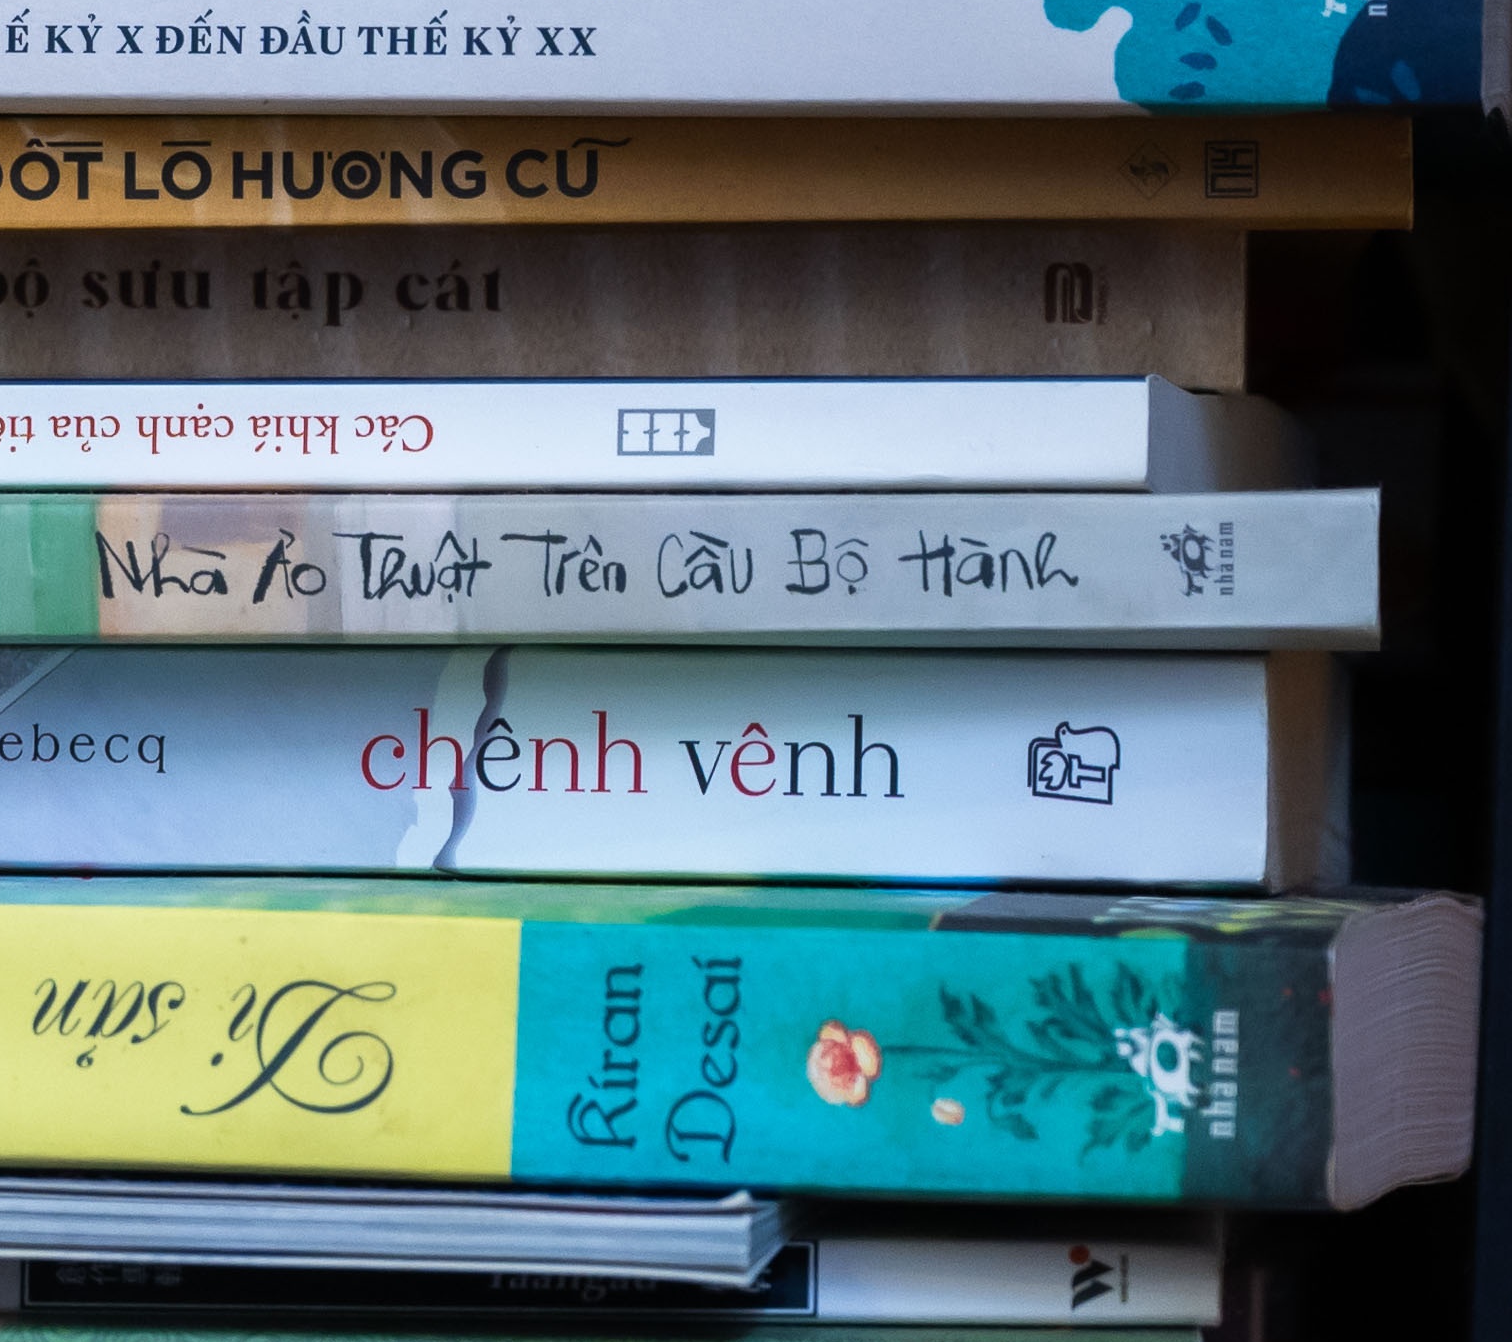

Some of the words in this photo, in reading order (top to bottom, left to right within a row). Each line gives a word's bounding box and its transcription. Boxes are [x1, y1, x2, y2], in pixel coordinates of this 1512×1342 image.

[45, 10, 103, 56] KỶ
[116, 22, 143, 55] X
[155, 10, 245, 56] ĐẾN
[260, 11, 349, 59] ĐẦU
[357, 9, 449, 58] THẾ
[462, 12, 525, 58] KỶ
[534, 25, 598, 58] XX
[504, 136, 633, 197] CŨ
[81, 264, 212, 310] sưu
[251, 259, 365, 328] tập
[395, 259, 503, 312] cát
[46, 414, 121, 456] của
[138, 402, 235, 454] cạnh
[250, 414, 339, 454] khía
[355, 412, 435, 452] Các
[94, 531, 227, 600] Nhà
[252, 527, 326, 602] Ảo
[333, 529, 491, 604] Thuật
[500, 531, 627, 596] Trên
[657, 530, 754, 597] Cầu
[786, 528, 869, 595] Bộ
[899, 530, 1078, 597] Hành
[360, 708, 647, 797] chênh
[679, 713, 905, 800] vênh
[32, 981, 185, 1069] sản
[179, 979, 397, 1116] Di
